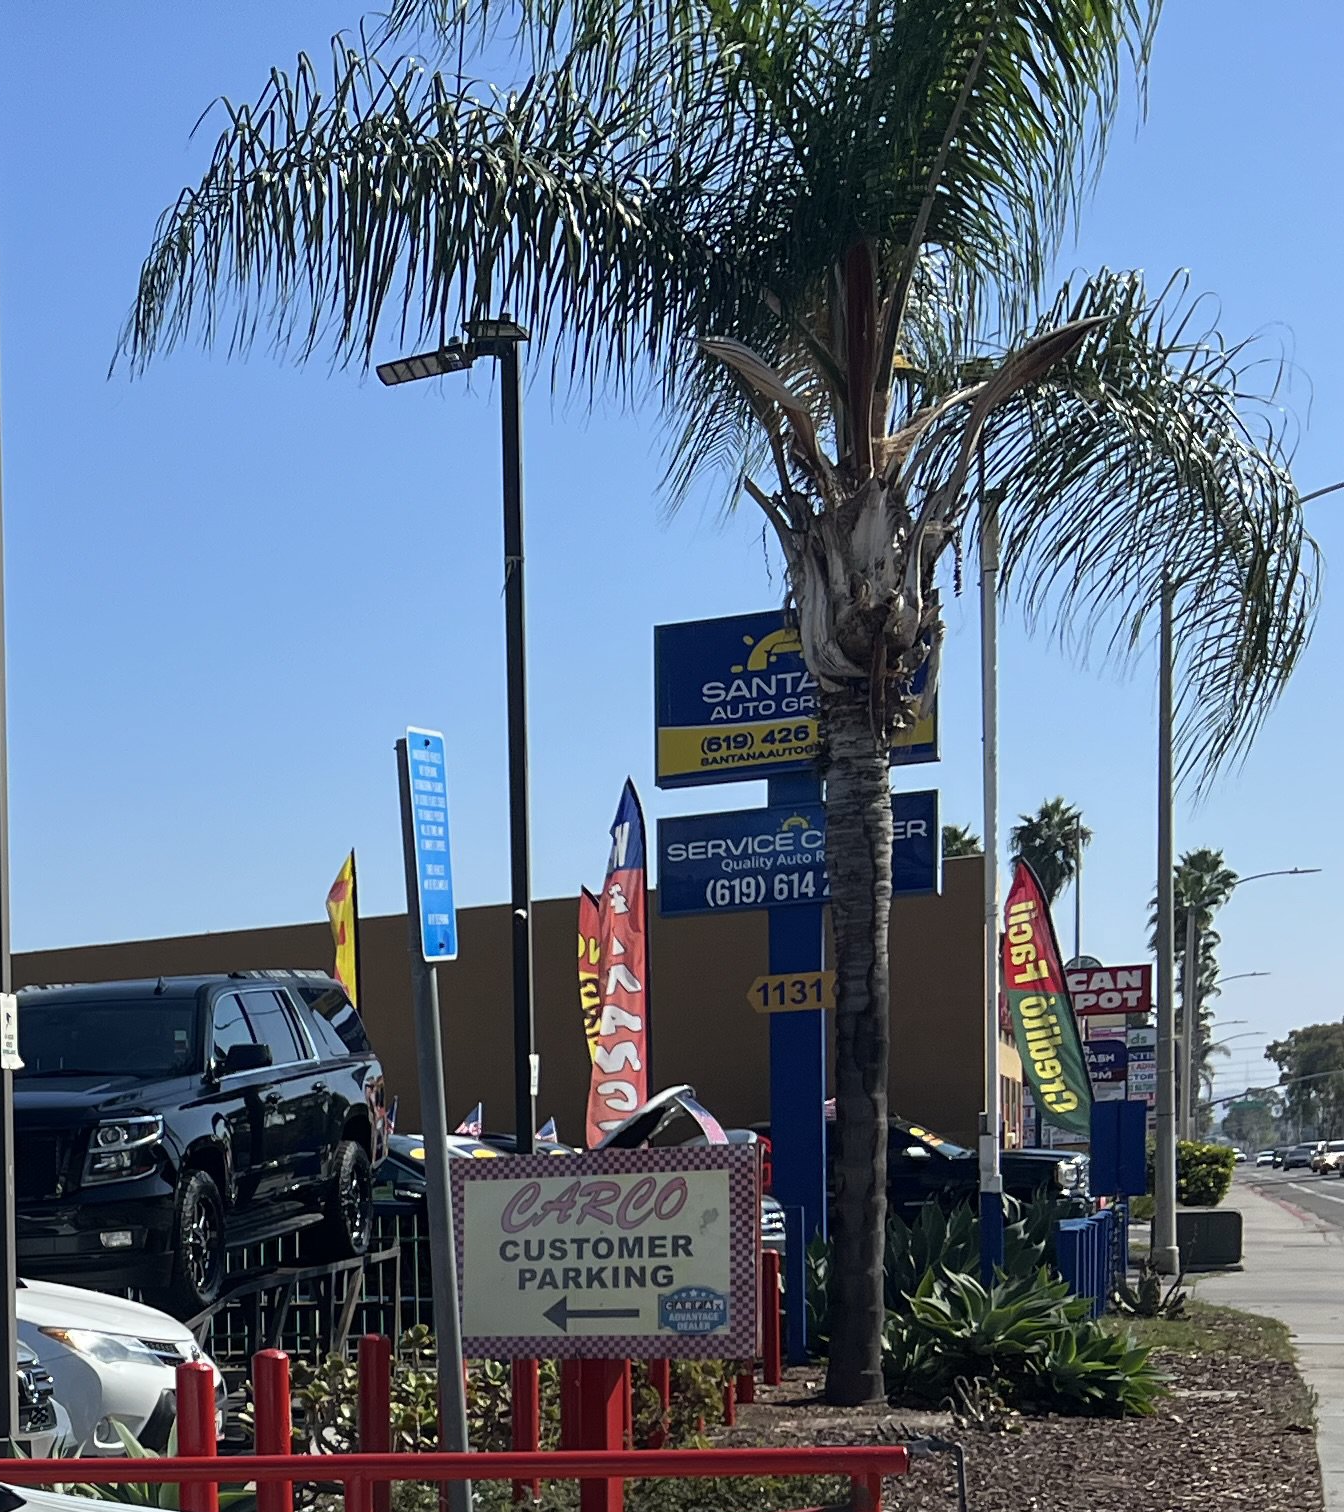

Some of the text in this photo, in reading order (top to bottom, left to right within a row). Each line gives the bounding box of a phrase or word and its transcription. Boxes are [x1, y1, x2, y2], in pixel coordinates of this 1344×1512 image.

[710, 702, 775, 721] AUTO
[701, 732, 754, 755] (619)
[761, 725, 809, 745] 426
[667, 832, 794, 862] SERVICE
[721, 856, 773, 873] Quality
[777, 852, 812, 867] Auto
[705, 876, 766, 908] (619)
[773, 871, 816, 901] 614
[756, 978, 823, 1007] 1131
[1068, 970, 1143, 993] CAN
[1072, 990, 1143, 1011] POT
[500, 1176, 688, 1234] CARCO
[499, 1235, 694, 1262] CUSTOMER
[518, 1265, 674, 1290] PARKING
[665, 1300, 724, 1311] CARFAX
